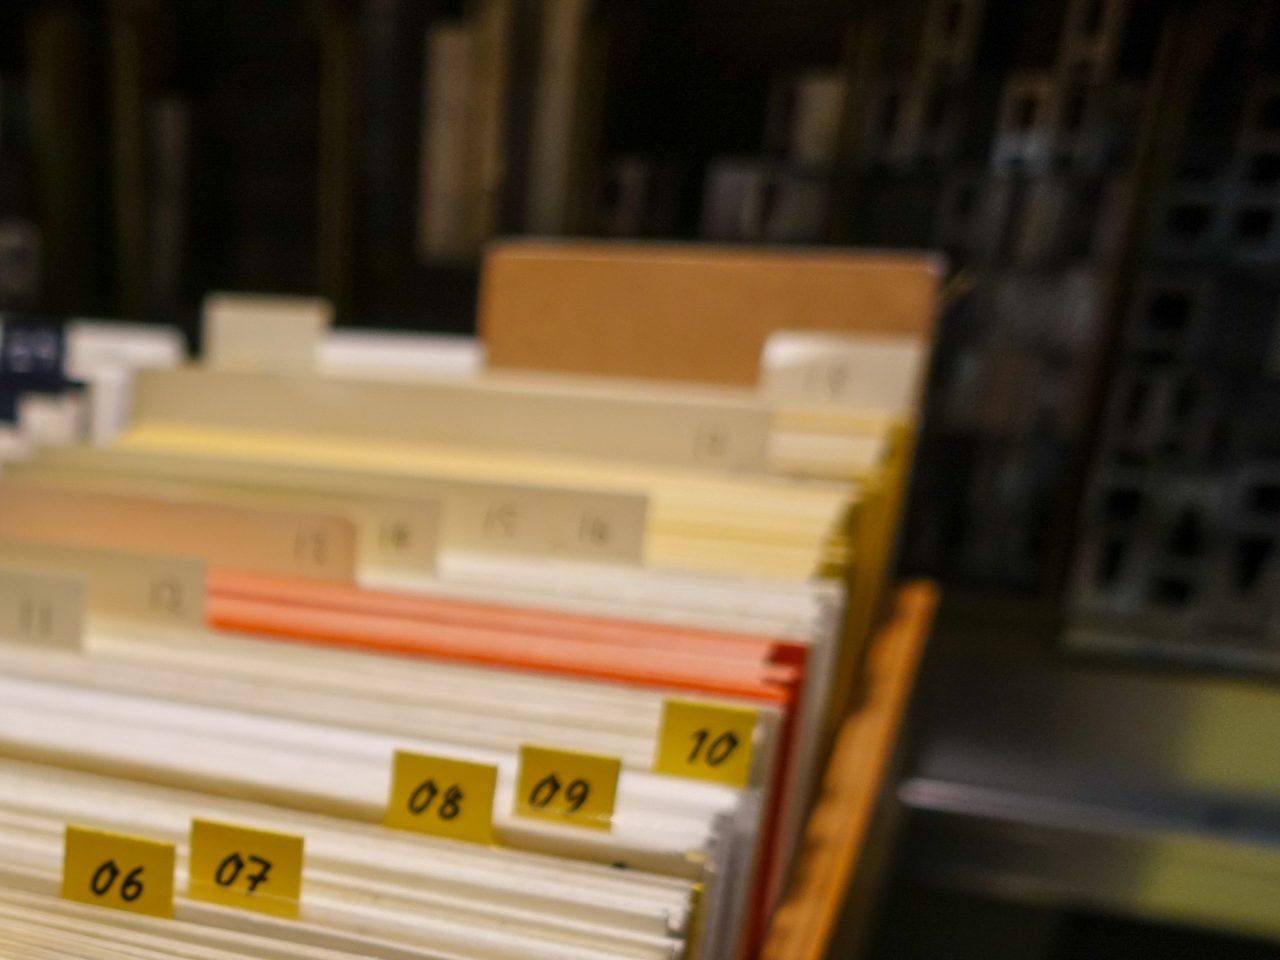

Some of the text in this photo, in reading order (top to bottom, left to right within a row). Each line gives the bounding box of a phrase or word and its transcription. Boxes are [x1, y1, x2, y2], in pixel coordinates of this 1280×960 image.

[688, 728, 740, 767] 10
[408, 778, 464, 821] 08
[528, 772, 591, 814] 09
[90, 859, 145, 903] 06
[214, 851, 273, 895] 07
